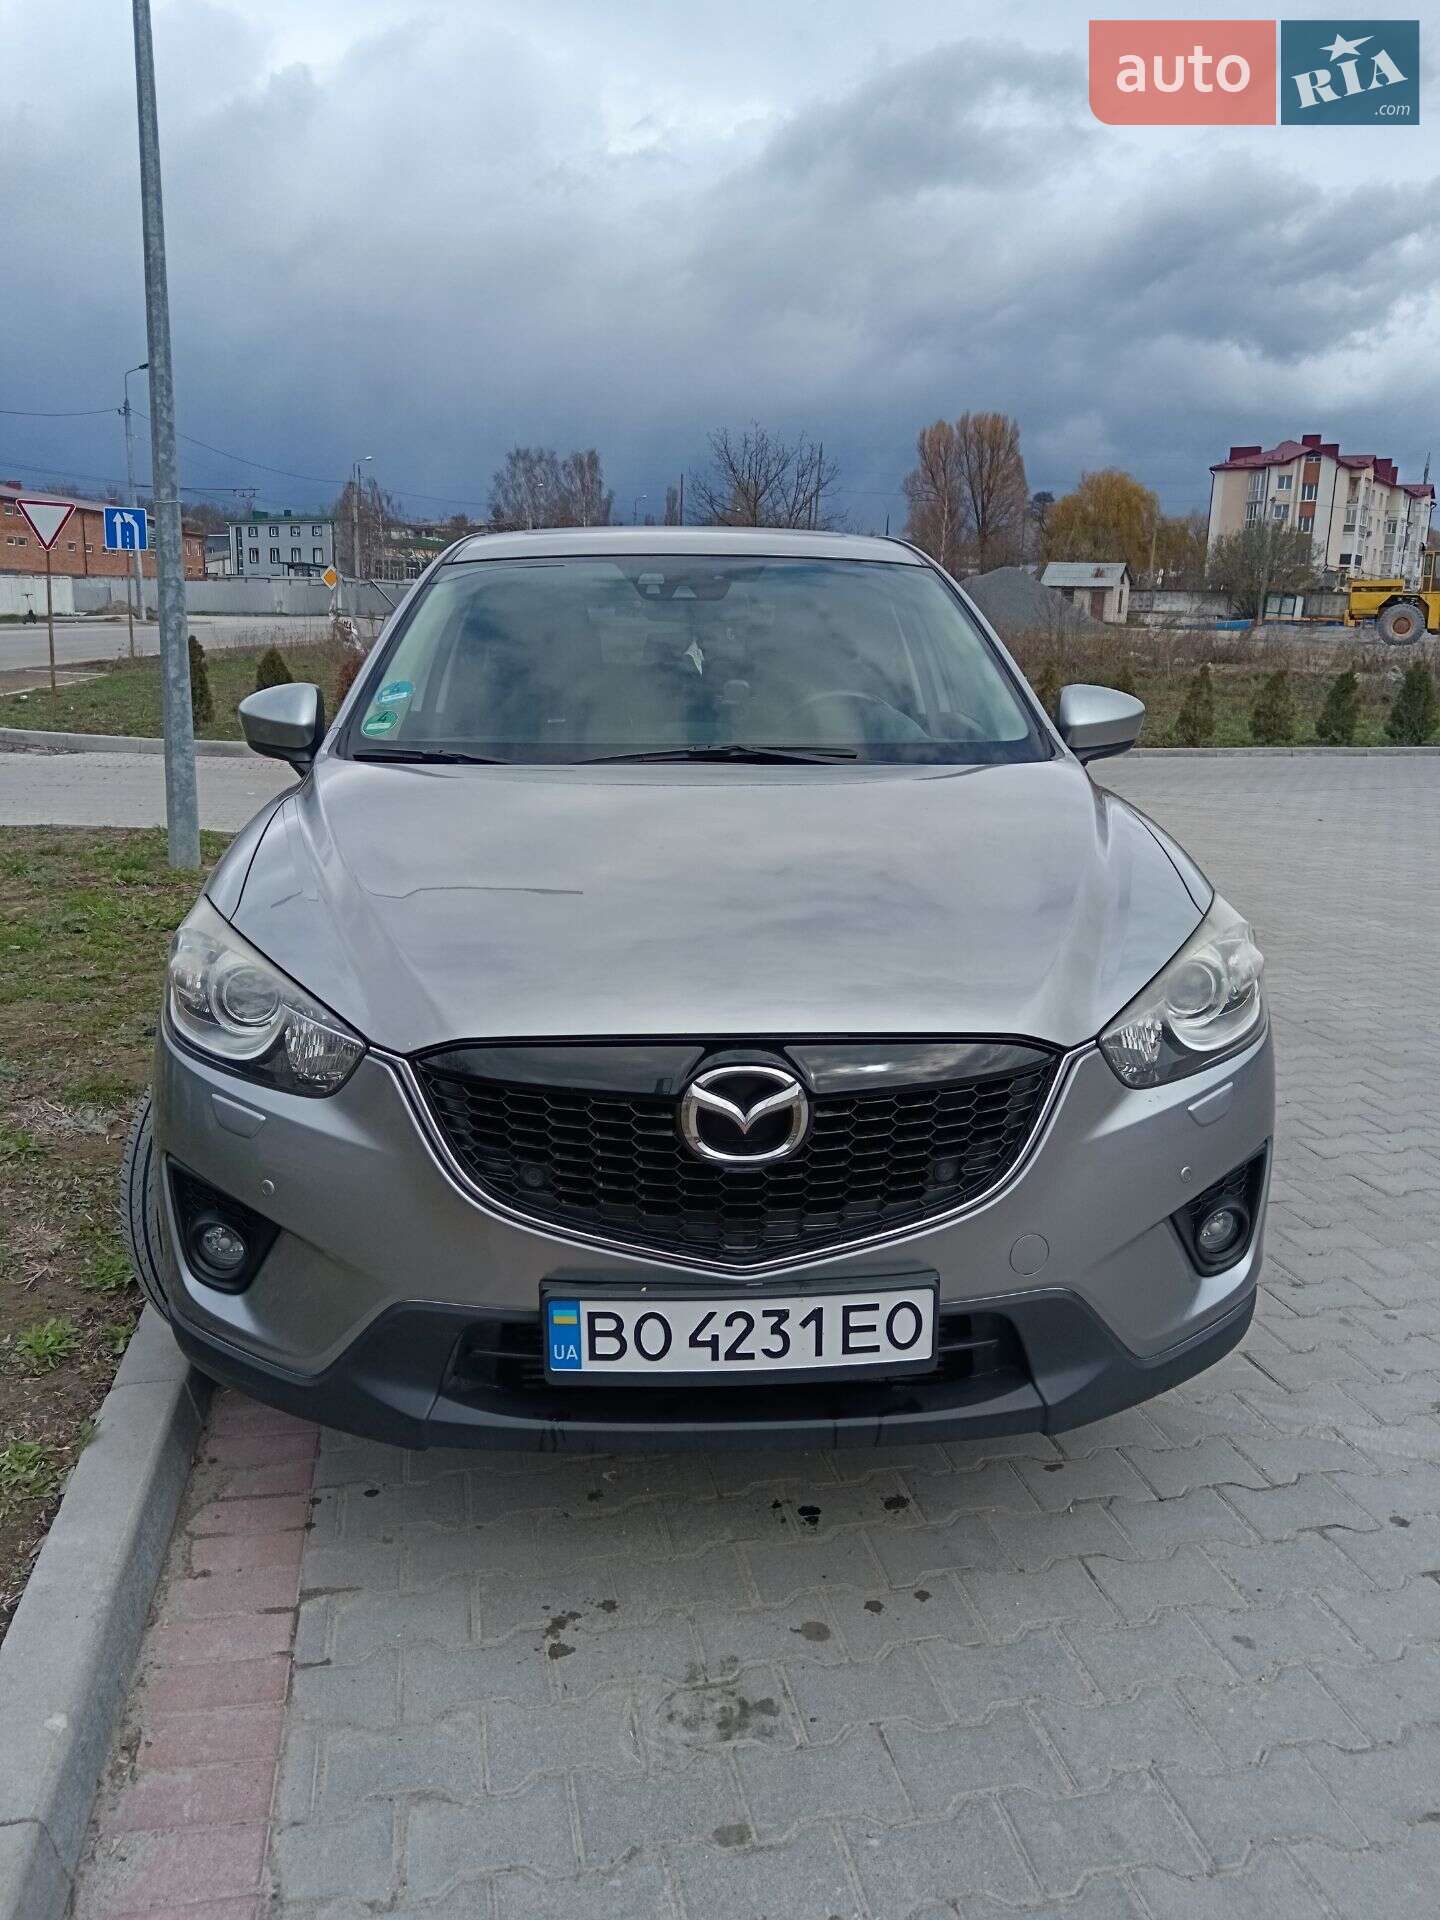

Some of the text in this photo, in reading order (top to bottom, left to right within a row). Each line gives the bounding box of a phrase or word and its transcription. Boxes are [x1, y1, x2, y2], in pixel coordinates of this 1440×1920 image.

[587, 1301, 923, 1362] BO 4231 EO
[553, 1344, 579, 1361] UA
